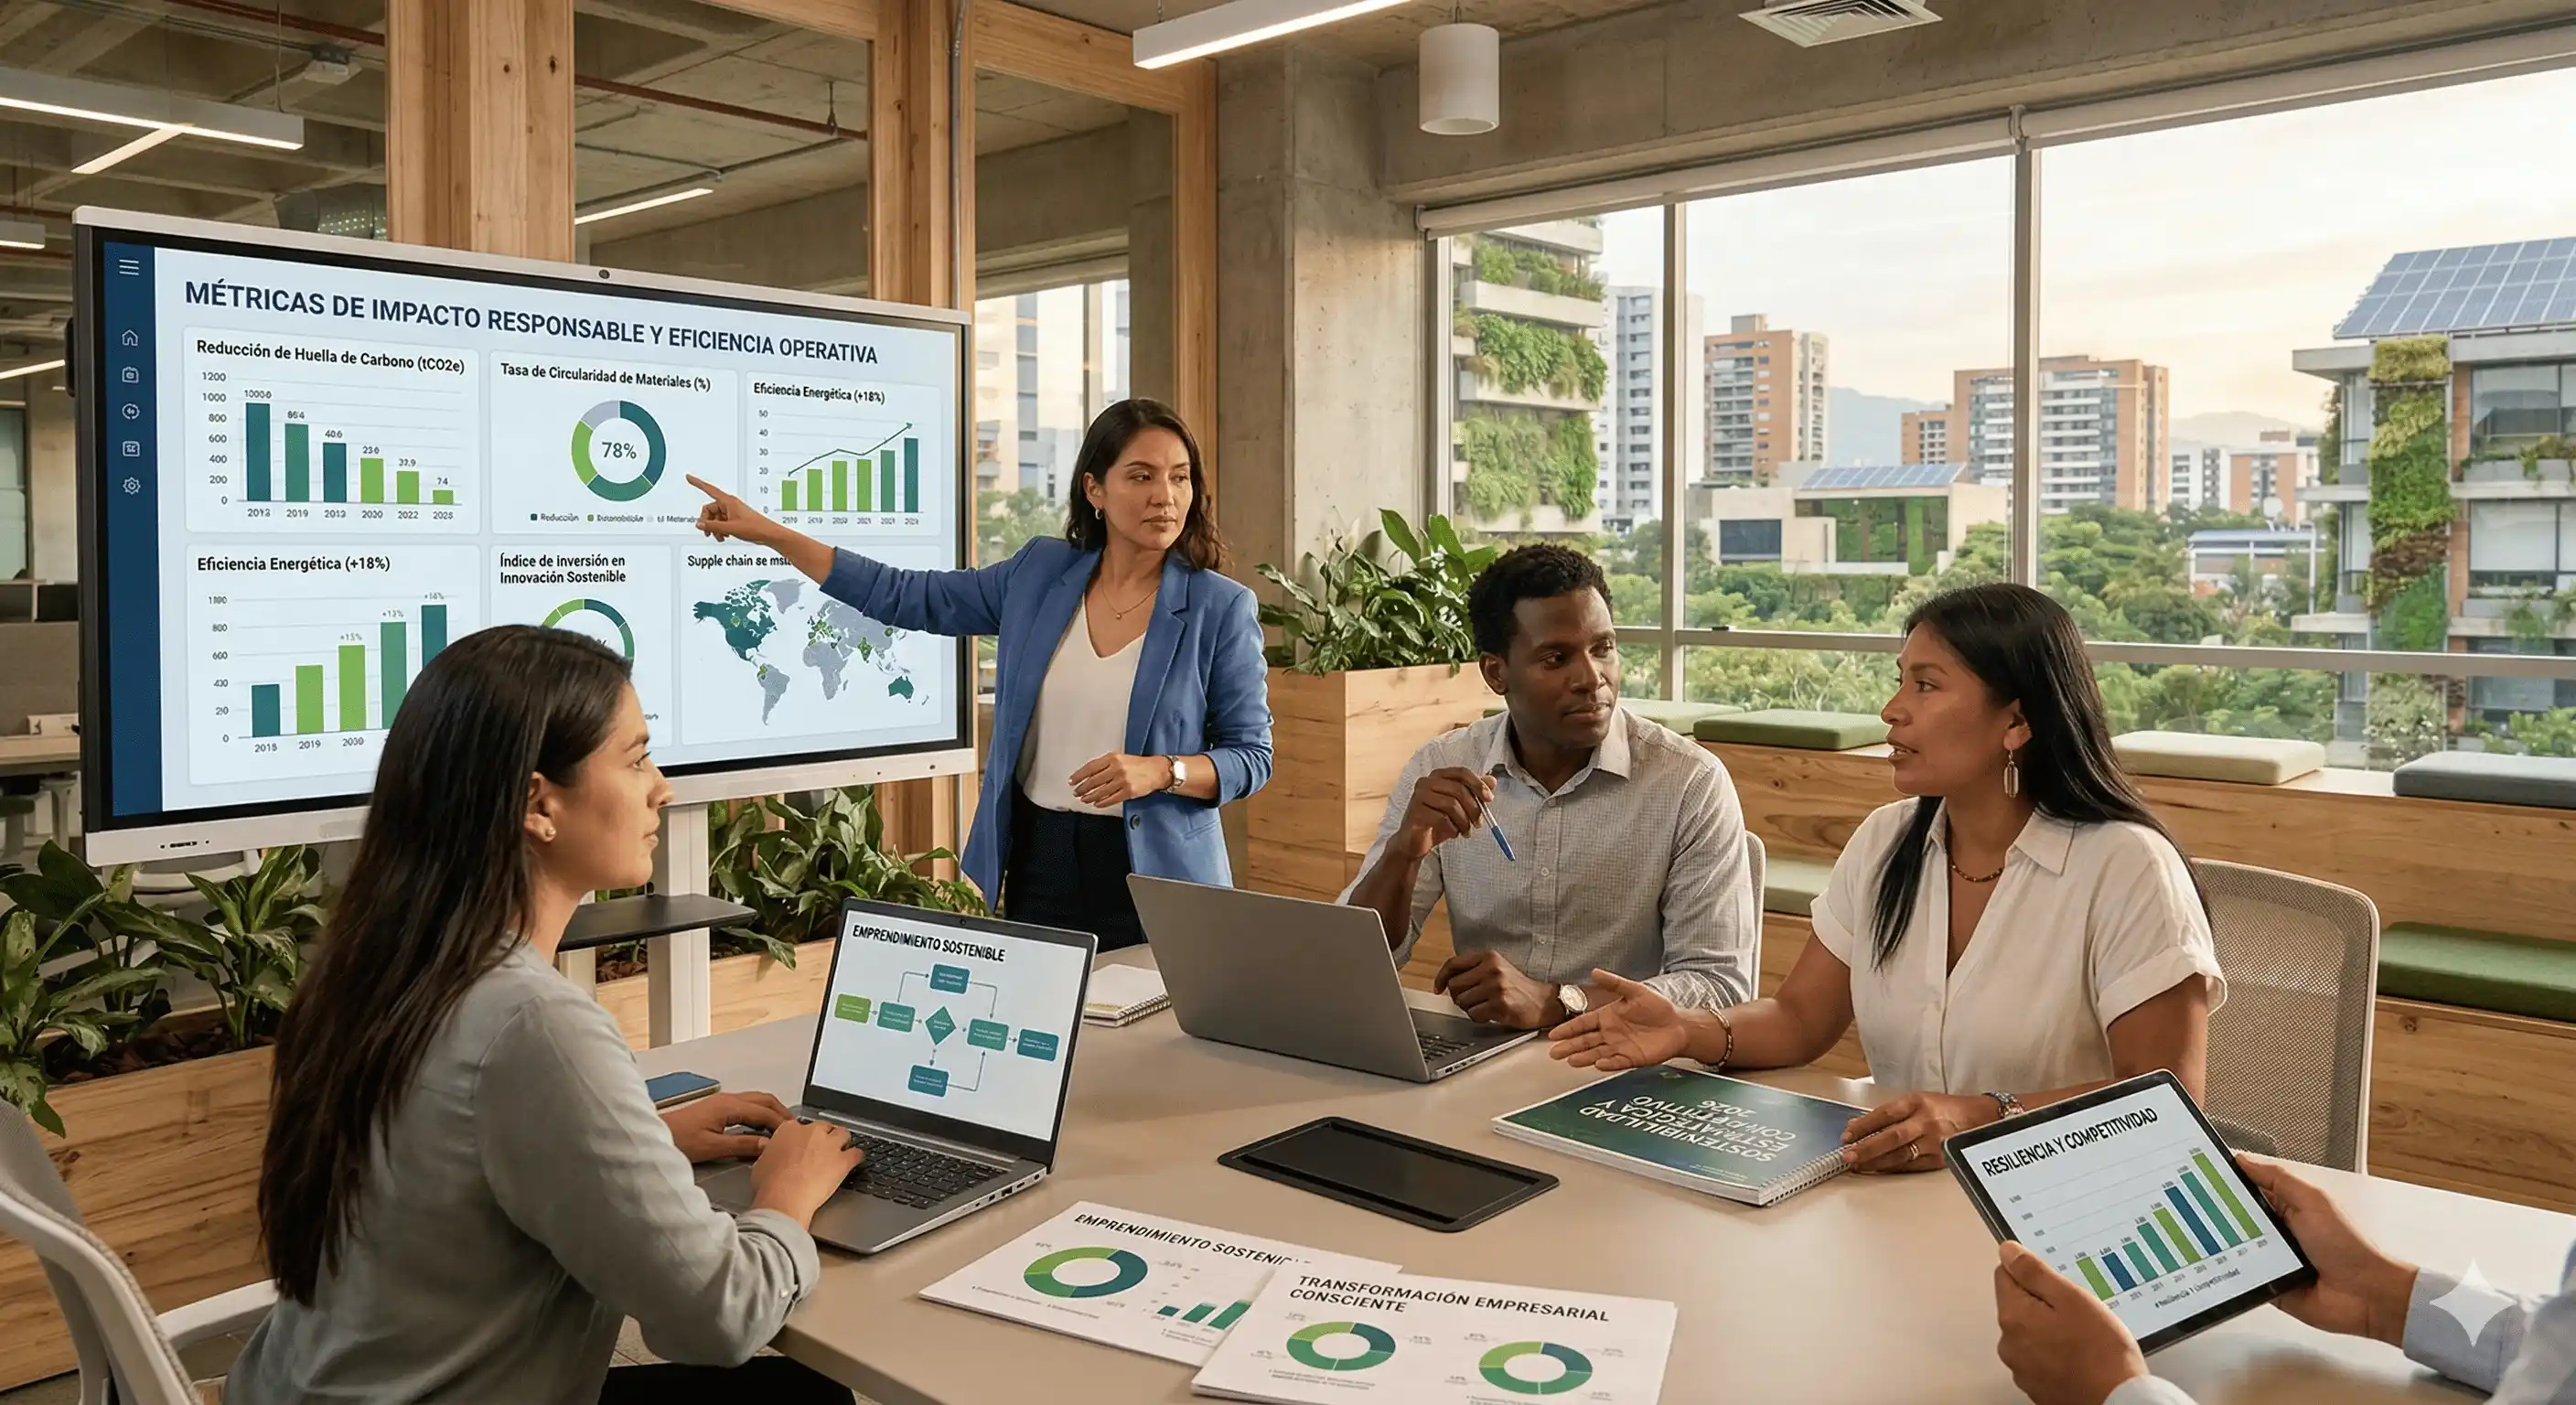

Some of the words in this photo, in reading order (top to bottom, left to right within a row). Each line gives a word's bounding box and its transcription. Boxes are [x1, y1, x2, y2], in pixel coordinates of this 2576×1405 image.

[186, 279, 325, 315] MÉTRICAS
[332, 295, 365, 318] DE
[372, 299, 480, 328] IMPACTO
[488, 310, 645, 344] RESPONSABLE
[649, 326, 664, 345] Y
[669, 327, 775, 355] EFICIENCIA
[779, 338, 878, 364] OPERATIVA
[197, 339, 271, 358] Reducción
[274, 346, 291, 359] de
[295, 348, 338, 362] Huella
[341, 350, 357, 364] de
[360, 353, 414, 369] Carbono
[417, 356, 465, 375] (tCO2e)
[202, 371, 227, 382] 1200
[500, 362, 530, 378] Tasa
[532, 365, 546, 378] de
[549, 366, 617, 383] Circularidad
[619, 370, 632, 384] de
[636, 373, 692, 390] Materiales
[694, 377, 711, 392] (%)
[202, 392, 227, 402] 1000
[803, 386, 853, 402] Energética
[209, 413, 227, 423] 800
[209, 434, 227, 444] 600
[601, 442, 638, 460] 78%
[209, 455, 228, 464] 400
[209, 476, 228, 485] 200
[221, 496, 228, 505] 0
[286, 509, 309, 519] 2019
[198, 557, 266, 571] Eficiencia
[270, 557, 342, 573] Energética
[345, 556, 391, 573] (+18%)
[499, 552, 536, 567] Índice
[539, 555, 553, 567] de
[611, 557, 626, 566] en
[687, 554, 724, 569] Supple
[725, 554, 753, 566] chain
[756, 557, 767, 566] se
[500, 572, 564, 584] Innovación
[567, 571, 626, 583] Sostenible
[222, 735, 229, 743] 0
[298, 741, 321, 749] 2019
[852, 925, 941, 951] EMPRENDIMIENTO
[942, 939, 1006, 962] SOSTENIBLE
[1594, 1099, 1617, 1110] Y
[1981, 1142, 2058, 1177] RESILIENCIA
[2053, 1137, 2066, 1153] Y
[2065, 1107, 2159, 1150] COMPETITIVIDAD
[1074, 1214, 1212, 1249] EMPRENDIMIENTO
[1212, 1242, 1311, 1266] SOSTENI
[1289, 1289, 1408, 1314] CONSCIENTE
[1298, 1274, 1470, 1306] TRANSFORMACIÓN
[1474, 1296, 1611, 1322] EMPRESARIAL
